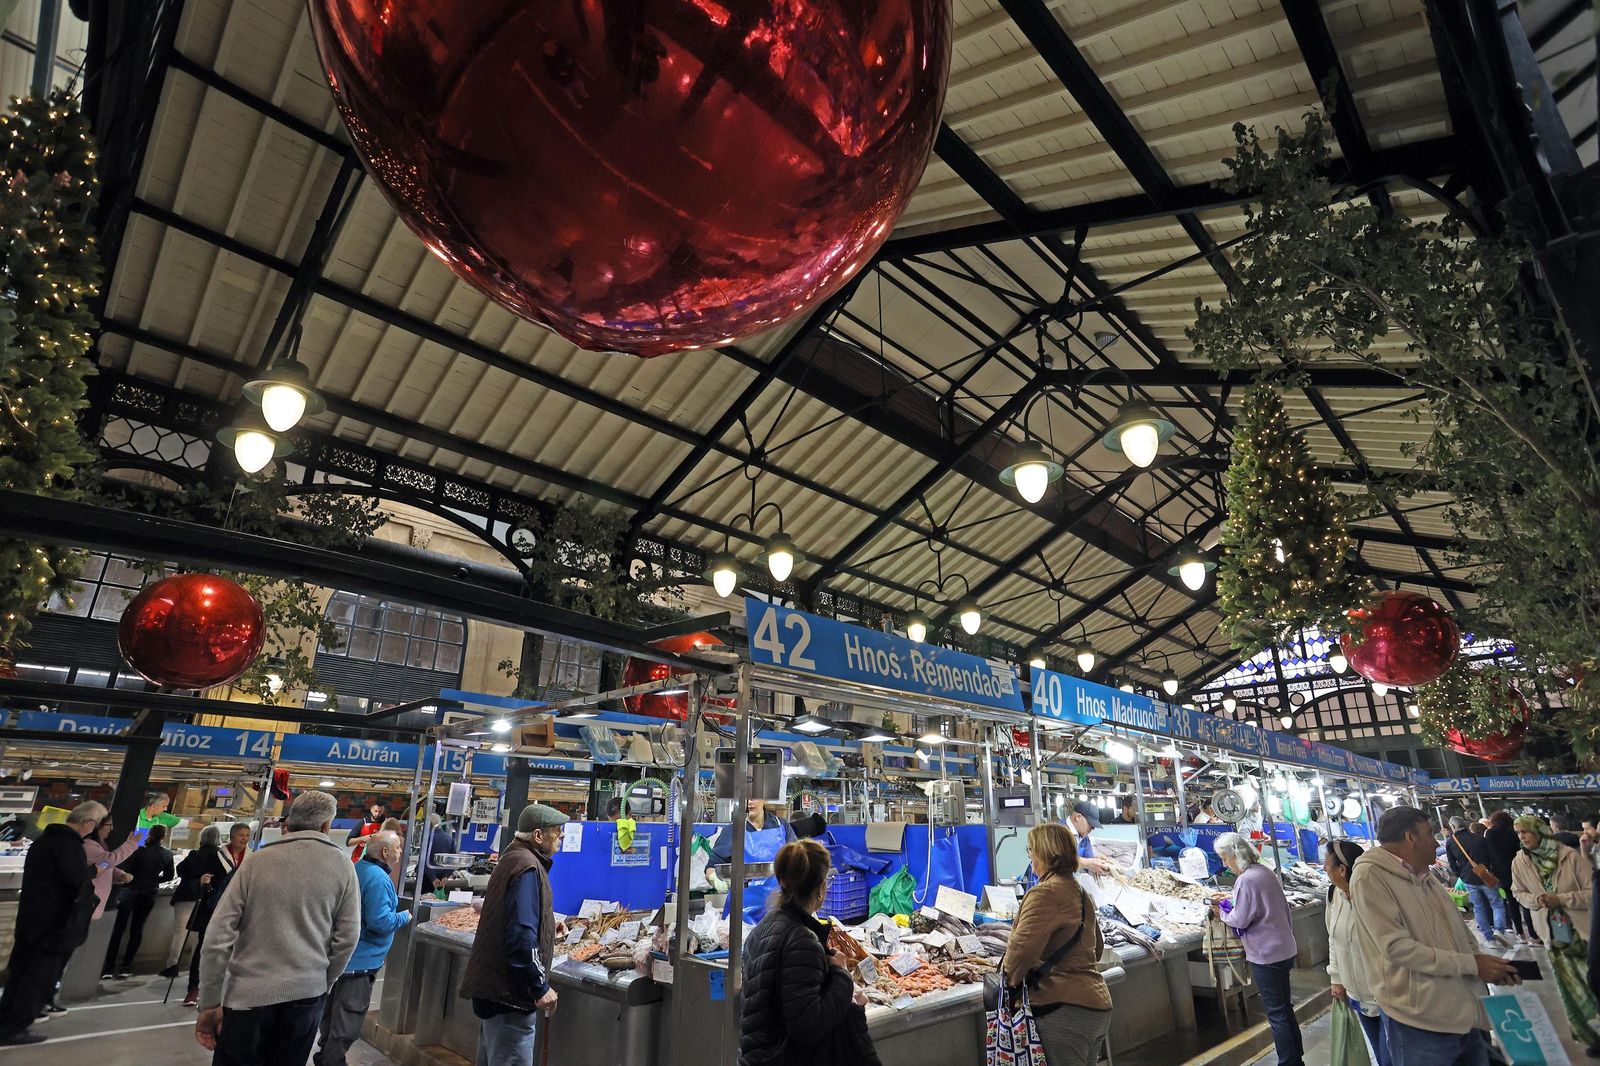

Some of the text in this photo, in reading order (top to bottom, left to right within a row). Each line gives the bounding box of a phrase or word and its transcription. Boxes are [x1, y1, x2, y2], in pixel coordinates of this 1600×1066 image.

[753, 607, 816, 671] 42
[844, 632, 908, 680] Hnos.
[909, 649, 1003, 699] Remendao
[1033, 671, 1063, 717] 40
[1075, 687, 1110, 720] Hnos.
[1111, 695, 1160, 730] Madrugón
[1173, 708, 1192, 739] 38
[160, 729, 212, 749] uñoz
[235, 730, 272, 757] 14
[327, 741, 400, 764] A.Durán
[1256, 728, 1271, 757] 36
[440, 749, 466, 771] 15
[1450, 778, 1472, 792] 25
[1489, 777, 1571, 790] Alonso y Antonio Flore
